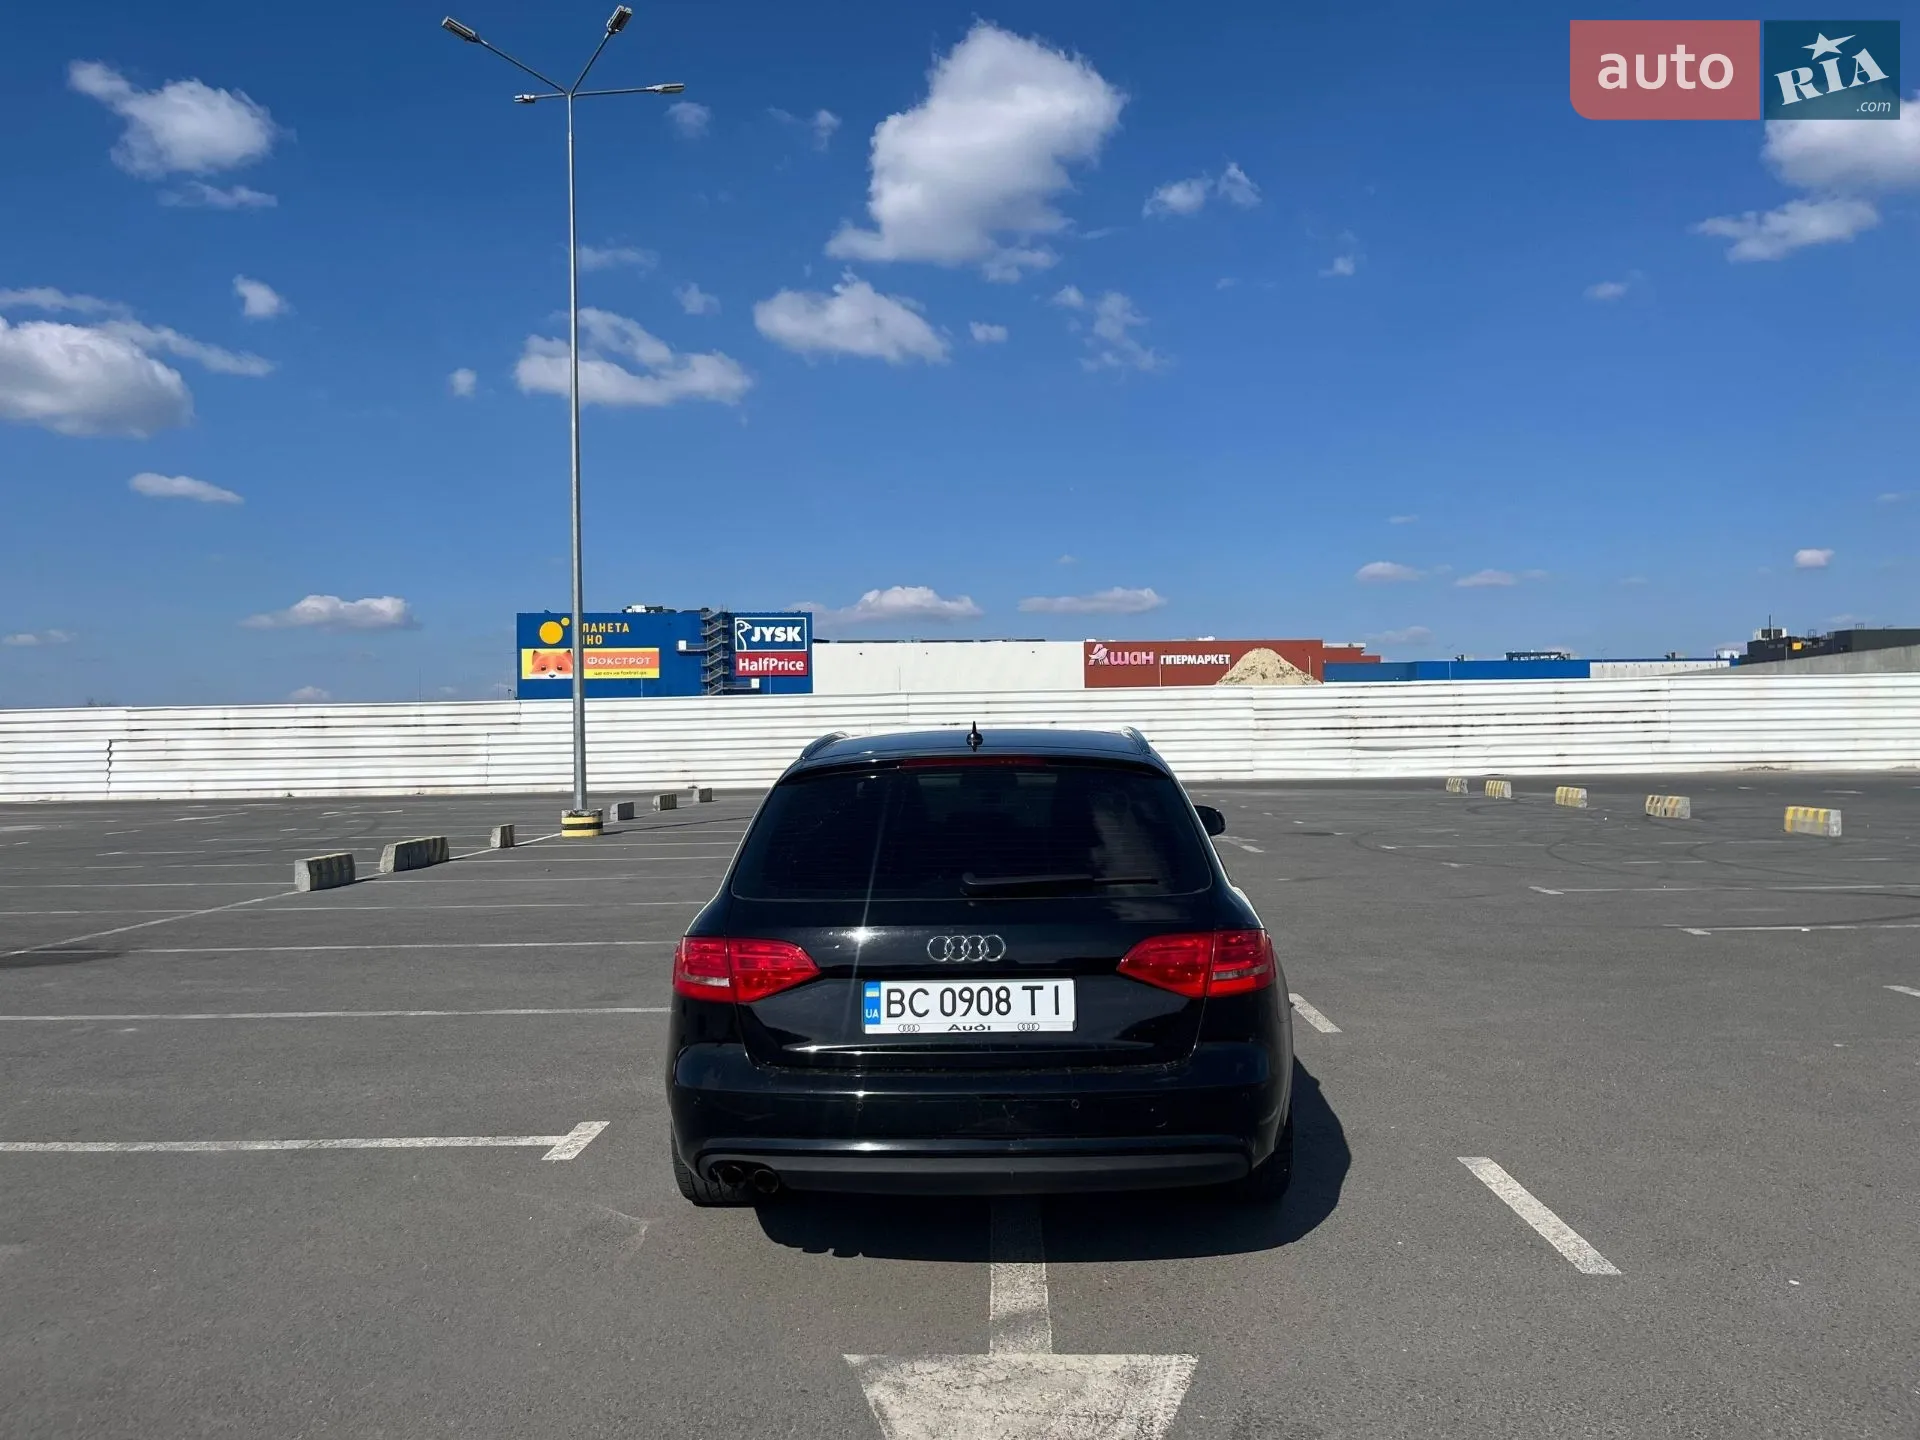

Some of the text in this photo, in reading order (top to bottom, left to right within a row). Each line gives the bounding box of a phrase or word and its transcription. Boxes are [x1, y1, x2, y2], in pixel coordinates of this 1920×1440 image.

[582, 622, 630, 633] ЛАНЕТА
[582, 634, 603, 645] ІНО
[751, 626, 802, 643] JYSK
[739, 657, 805, 672] HalfPrice
[1160, 654, 1231, 665] ГІПЕРМАРКЕТ
[886, 988, 930, 1018] BC
[939, 986, 1012, 1017] 0908
[865, 1009, 880, 1019] UA
